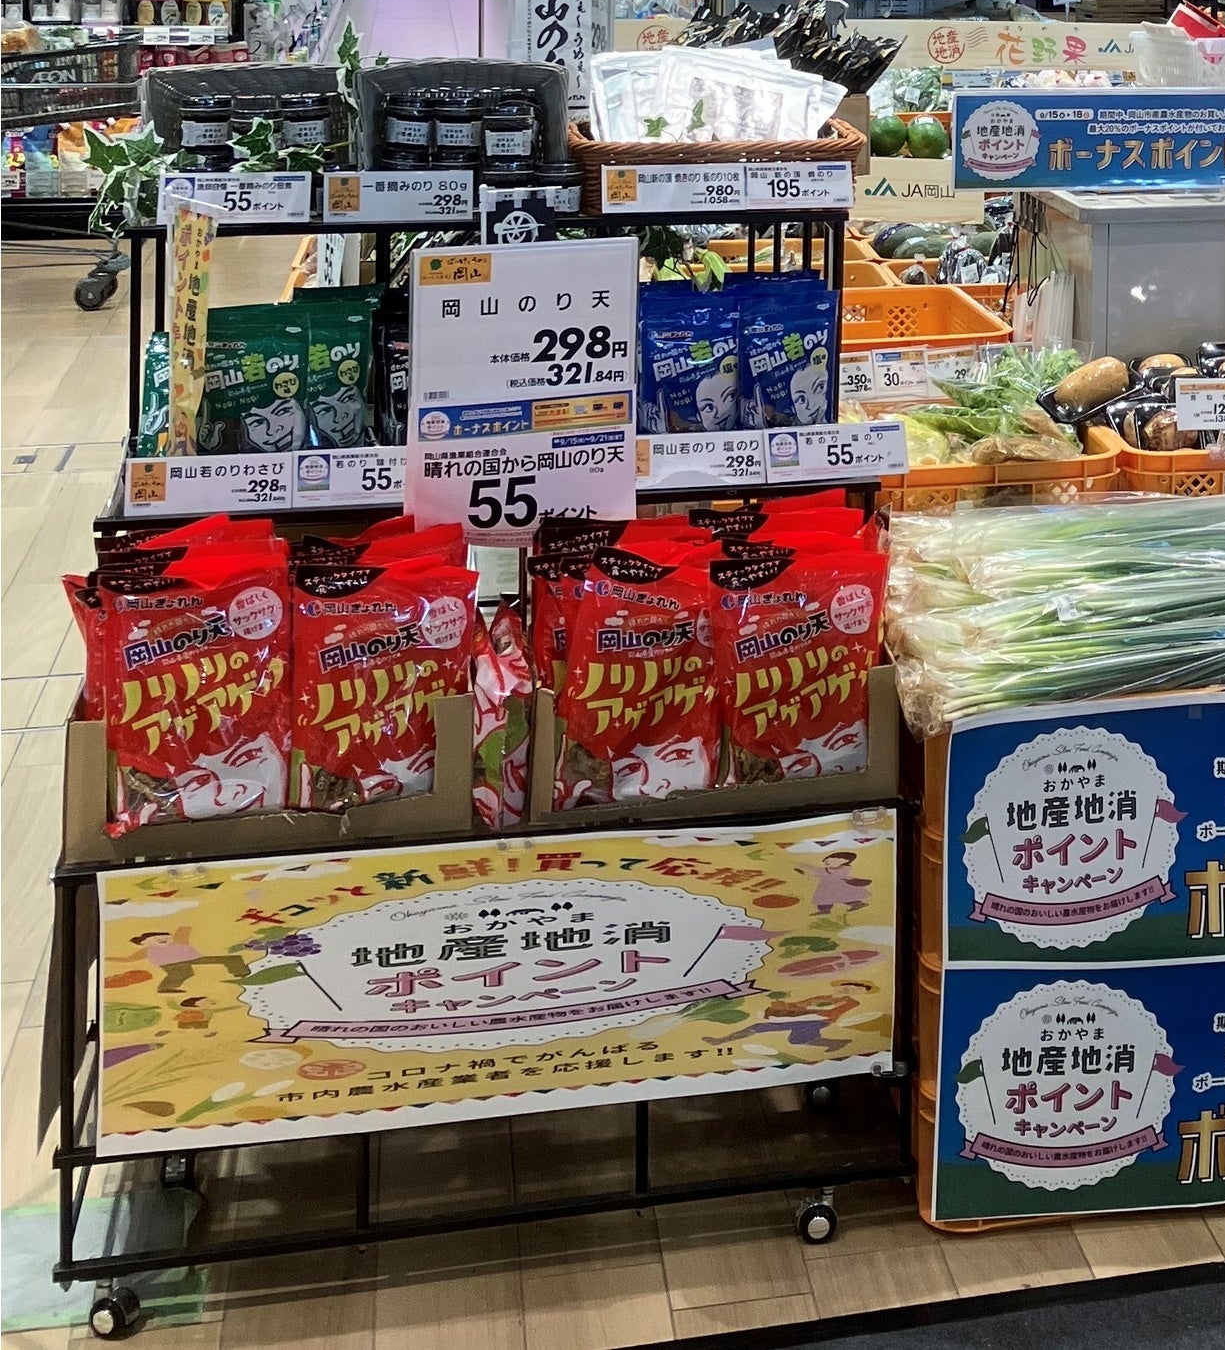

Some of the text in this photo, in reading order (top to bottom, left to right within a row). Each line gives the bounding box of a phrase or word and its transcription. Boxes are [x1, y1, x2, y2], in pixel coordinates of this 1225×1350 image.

[932, 31, 958, 46] 地産
[995, 31, 1088, 64] 花野果
[934, 45, 961, 59] 地消
[976, 124, 1025, 137] 地産地消
[978, 139, 1026, 151] ポイント
[981, 151, 1019, 160] キャンペーン
[362, 180, 467, 193] 一番摘みのり 80g
[767, 179, 830, 198] 195 ポイント
[901, 184, 956, 200] JA岡山
[223, 190, 284, 212] 55 ポイント
[441, 289, 611, 319] 岡山のり天
[490, 352, 530, 364] 本体価格
[883, 372, 900, 387] 30
[453, 420, 530, 438] ボーナスポイント
[805, 432, 884, 445] 若のり 塩のり
[652, 440, 760, 456] 岡山若のり 塩のり
[826, 443, 885, 466] 55 ポイント
[170, 462, 285, 480] 岡山若のりわさび
[335, 459, 368, 469] 若のり
[423, 446, 625, 479] 晴れの国から岡山のり天
[361, 466, 392, 491] 55
[467, 475, 598, 530] 55 ポイント
[126, 595, 204, 611] 岡山ぎょれん
[322, 600, 397, 616] 岡山ぎょれん
[609, 583, 681, 611] 岡山ぎょれん
[735, 589, 807, 607] 岡山ぎょれん
[122, 614, 236, 672] 岡山のり天
[318, 622, 422, 673] 岡山のり天
[596, 621, 696, 654] 岡山のり天
[734, 610, 832, 664] 岡山のり天
[118, 650, 250, 725] ノリノリの
[575, 655, 703, 701] ノリノリの
[733, 644, 850, 709] ノリノリの
[310, 659, 438, 726] ノリノリの
[1043, 775, 1107, 793] おかやま
[1005, 790, 1138, 832] 地産地消
[1012, 828, 1139, 871] ポイント
[1022, 867, 1124, 895] キャンペーン
[443, 912, 595, 936] おかやま
[351, 919, 671, 968] 地産地消
[365, 950, 671, 997] ポイント
[389, 977, 637, 1013] キャンペーン
[1040, 1027, 1105, 1042] おかやま
[366, 1041, 659, 1081] コロナ禍でがんばる
[1001, 1043, 1136, 1078] 地産地消
[276, 1047, 734, 1103] 市内農水産業者を応援します!!
[1004, 1080, 1133, 1115] ポイント
[1013, 1116, 1118, 1138] キャンペーン
